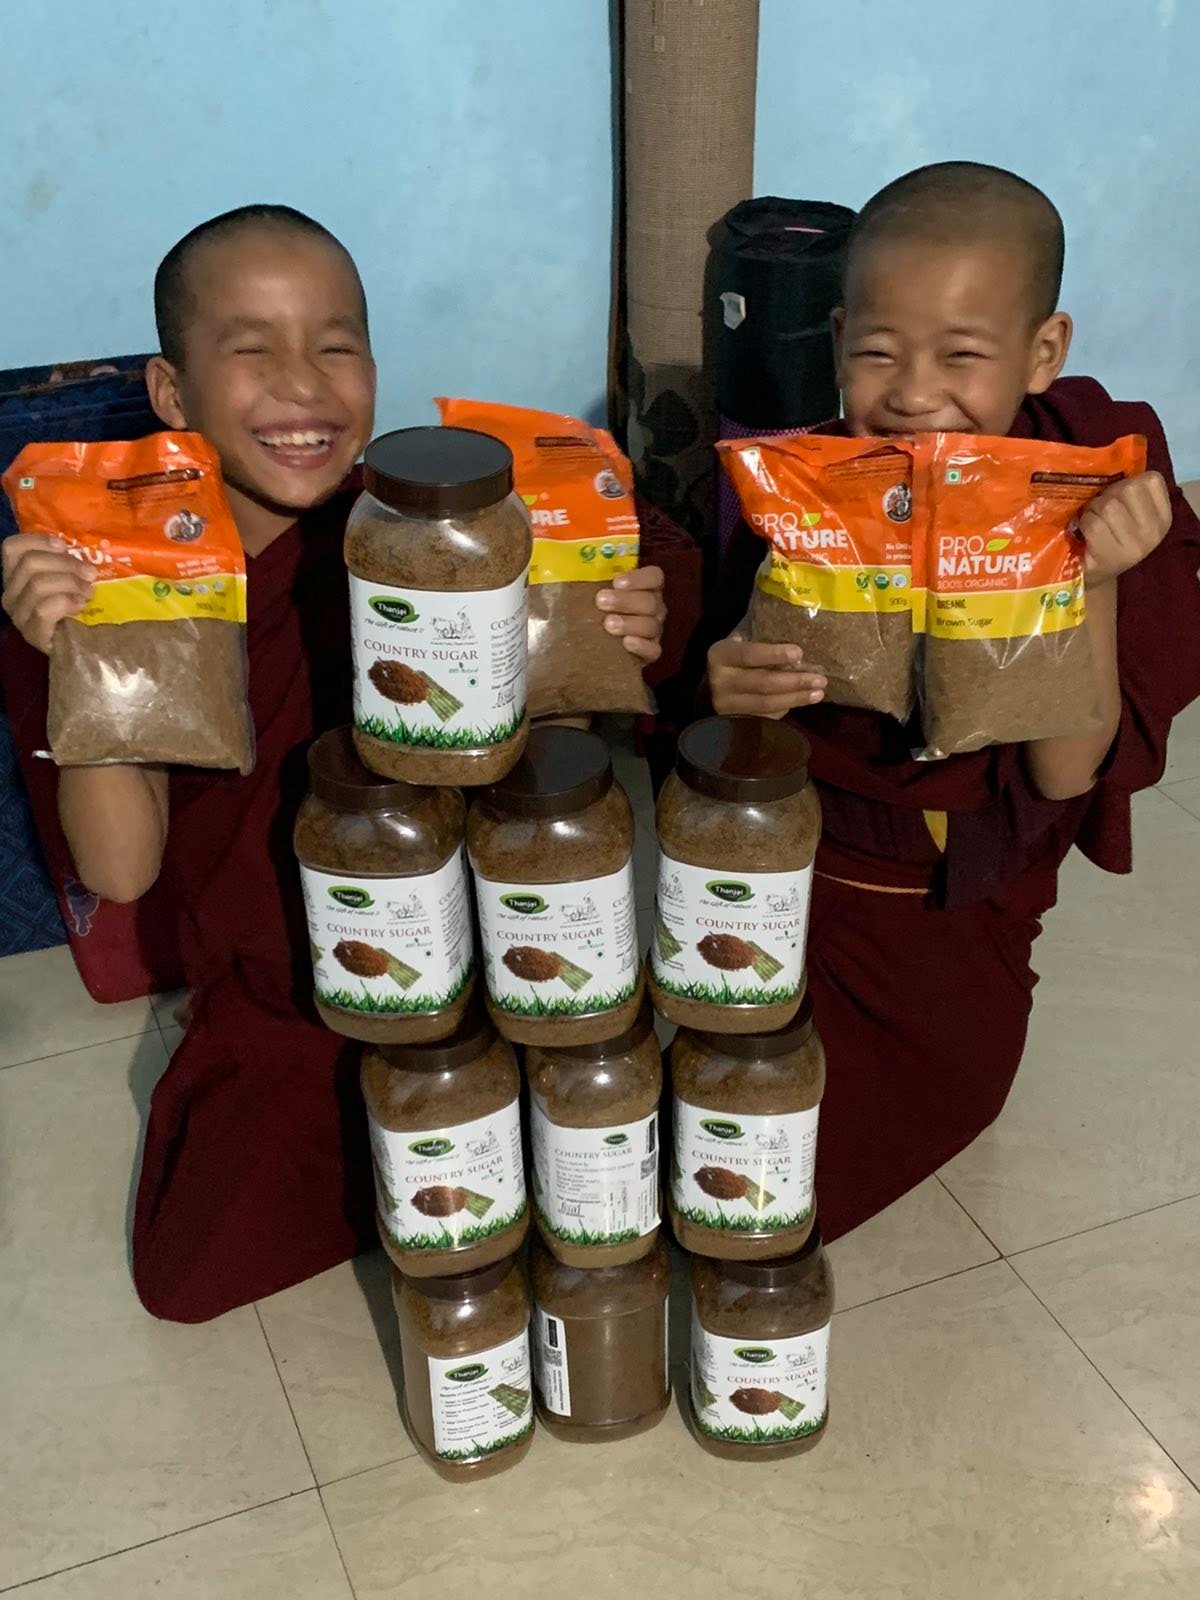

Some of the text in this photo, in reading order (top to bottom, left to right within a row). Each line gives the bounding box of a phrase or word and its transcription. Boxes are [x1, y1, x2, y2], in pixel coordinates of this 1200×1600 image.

[751, 512, 798, 533] PRO
[772, 528, 849, 551] ATURE
[938, 535, 985, 556] PRO
[937, 552, 1033, 577] NATURE
[936, 617, 993, 629] Brown Sugar
[363, 638, 479, 661] COUNTRY SUGAR
[327, 922, 386, 938] COUNTRY
[388, 925, 432, 938] SUGAR
[695, 916, 800, 931] COUNTRY SUGAR
[496, 927, 604, 942] COUNTRY SUGAR
[555, 1147, 632, 1160] COUNTRY SUGAR
[692, 1149, 749, 1166] COUNTRY
[405, 1169, 464, 1184] COUNTRY
[467, 1155, 504, 1174] SUGAR
[727, 1368, 819, 1385] COUNTRY SUGAR
